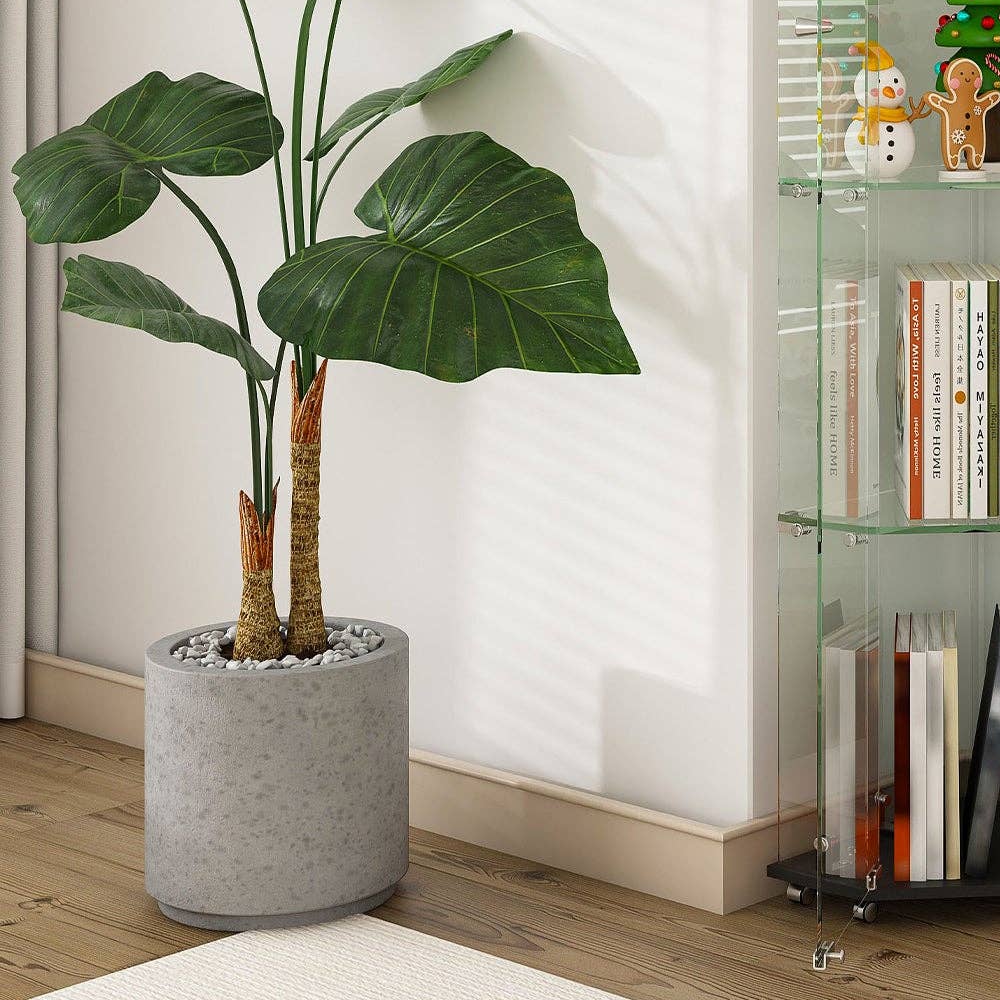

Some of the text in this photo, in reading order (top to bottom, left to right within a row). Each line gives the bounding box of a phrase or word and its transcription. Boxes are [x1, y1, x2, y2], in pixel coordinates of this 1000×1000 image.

[849, 342, 857, 370] With
[849, 373, 857, 398] Love
[829, 370, 838, 477] feels like HOME
